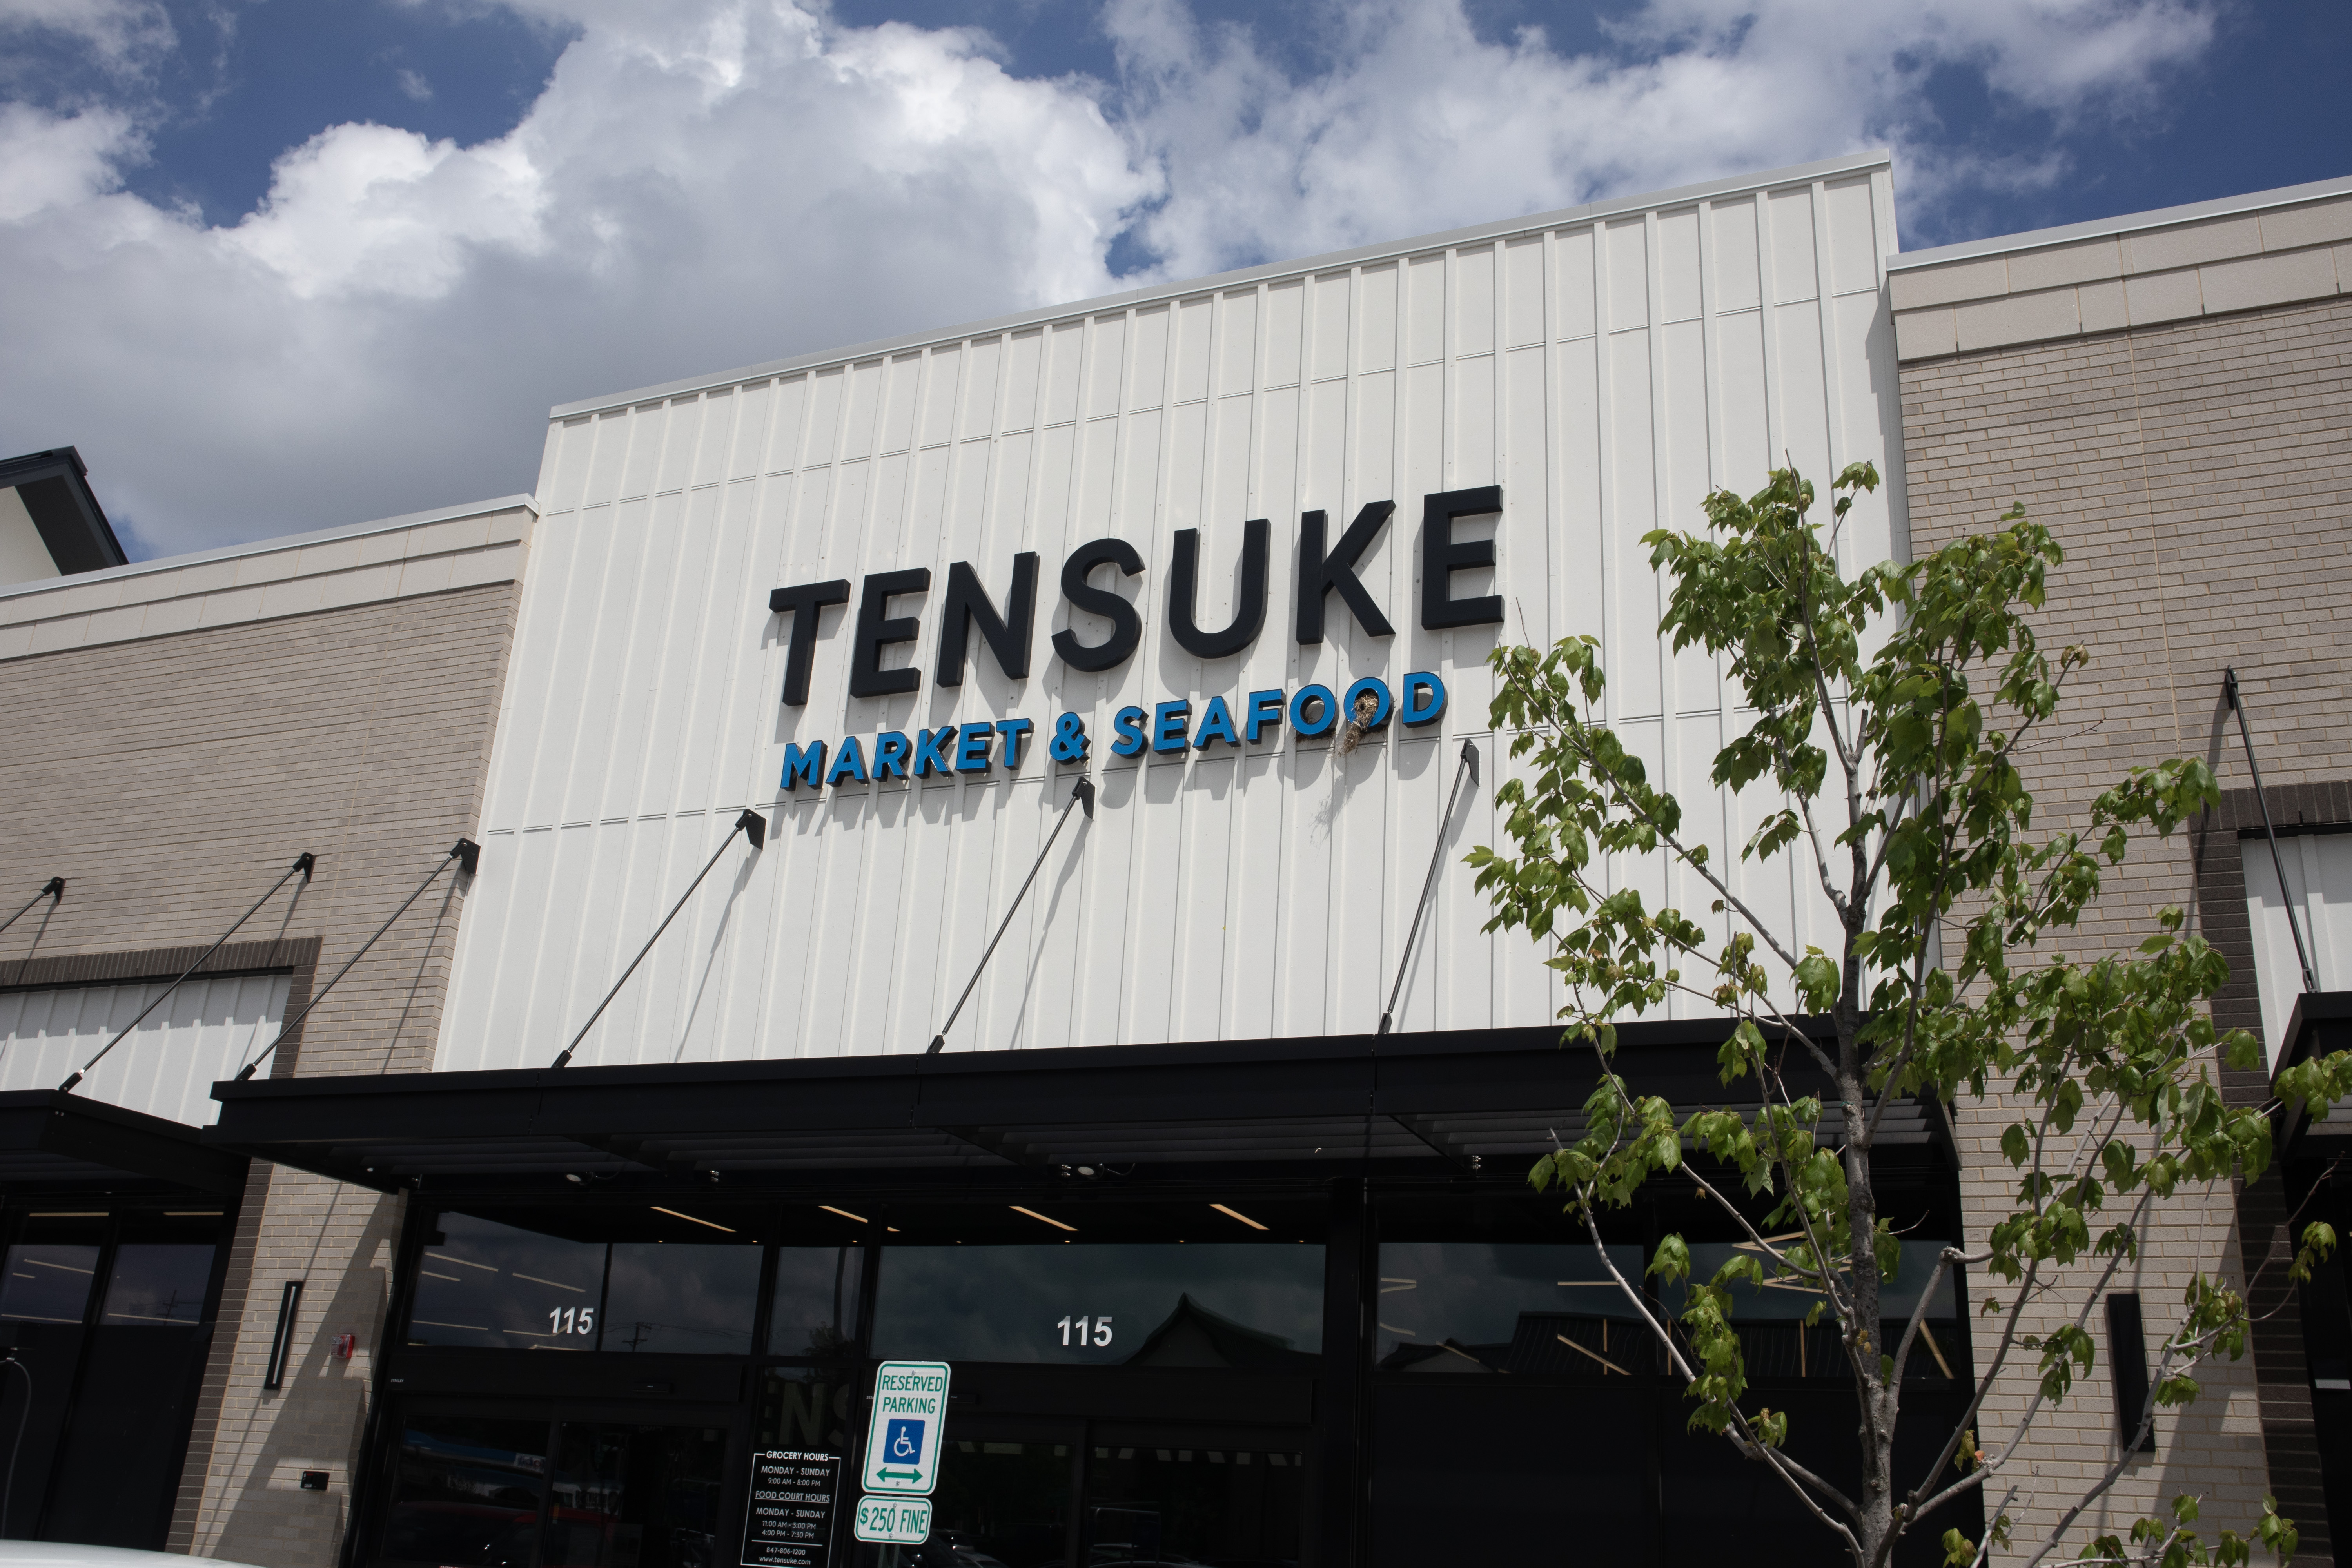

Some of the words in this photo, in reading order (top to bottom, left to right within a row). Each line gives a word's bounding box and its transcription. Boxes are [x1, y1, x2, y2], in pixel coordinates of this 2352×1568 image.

[769, 485, 1505, 706] TENSUKE
[780, 718, 1034, 791] MARKET
[1050, 712, 1091, 765] &
[1110, 671, 1447, 759] SEAFOOD
[550, 1307, 594, 1334] 115
[1058, 1316, 1112, 1346] 115
[882, 1375, 943, 1392] RESERVED
[882, 1397, 936, 1414] PARKING
[766, 1451, 802, 1460] GROCERY
[804, 1453, 829, 1461] HOURS
[761, 1466, 794, 1474] MONDAY
[800, 1468, 830, 1476] SUNDAY
[779, 1492, 804, 1501] COURT
[805, 1494, 830, 1502] HOURS
[756, 1507, 789, 1516] MONDAY
[796, 1510, 826, 1518] SUNDAY
[860, 1506, 895, 1532] $250
[900, 1509, 927, 1534] FINE
[766, 1547, 806, 1555] 847-806-1200
[759, 1556, 811, 1565] www.tensuke.com
